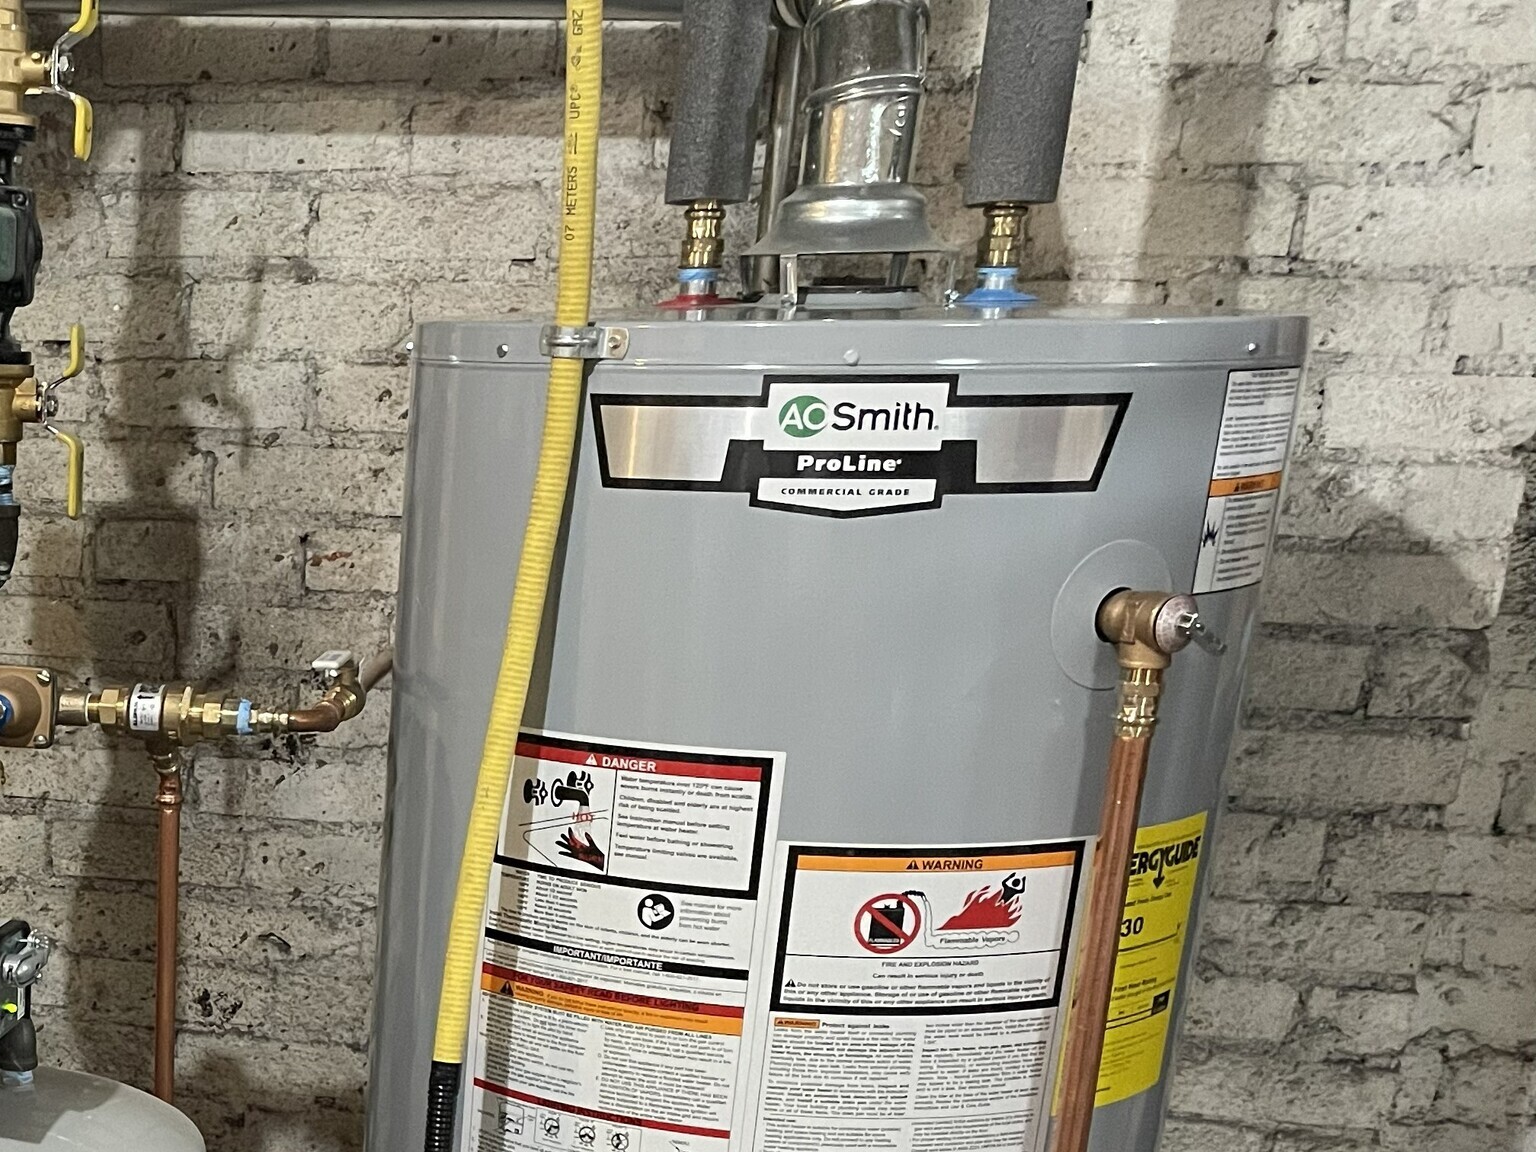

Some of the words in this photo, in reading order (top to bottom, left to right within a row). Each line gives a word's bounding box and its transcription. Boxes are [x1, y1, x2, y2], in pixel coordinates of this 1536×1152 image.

[566, 166, 578, 216] METERS
[797, 455, 897, 472] ProLine
[782, 488, 862, 496] COMMERCIAL
[869, 488, 910, 496] GRADE
[602, 756, 656, 772] DANGER
[922, 858, 984, 870] WARNING
[1130, 836, 1201, 876] ERGYGUIDE
[553, 944, 663, 970] IMPORTANT/IMPORTANTE
